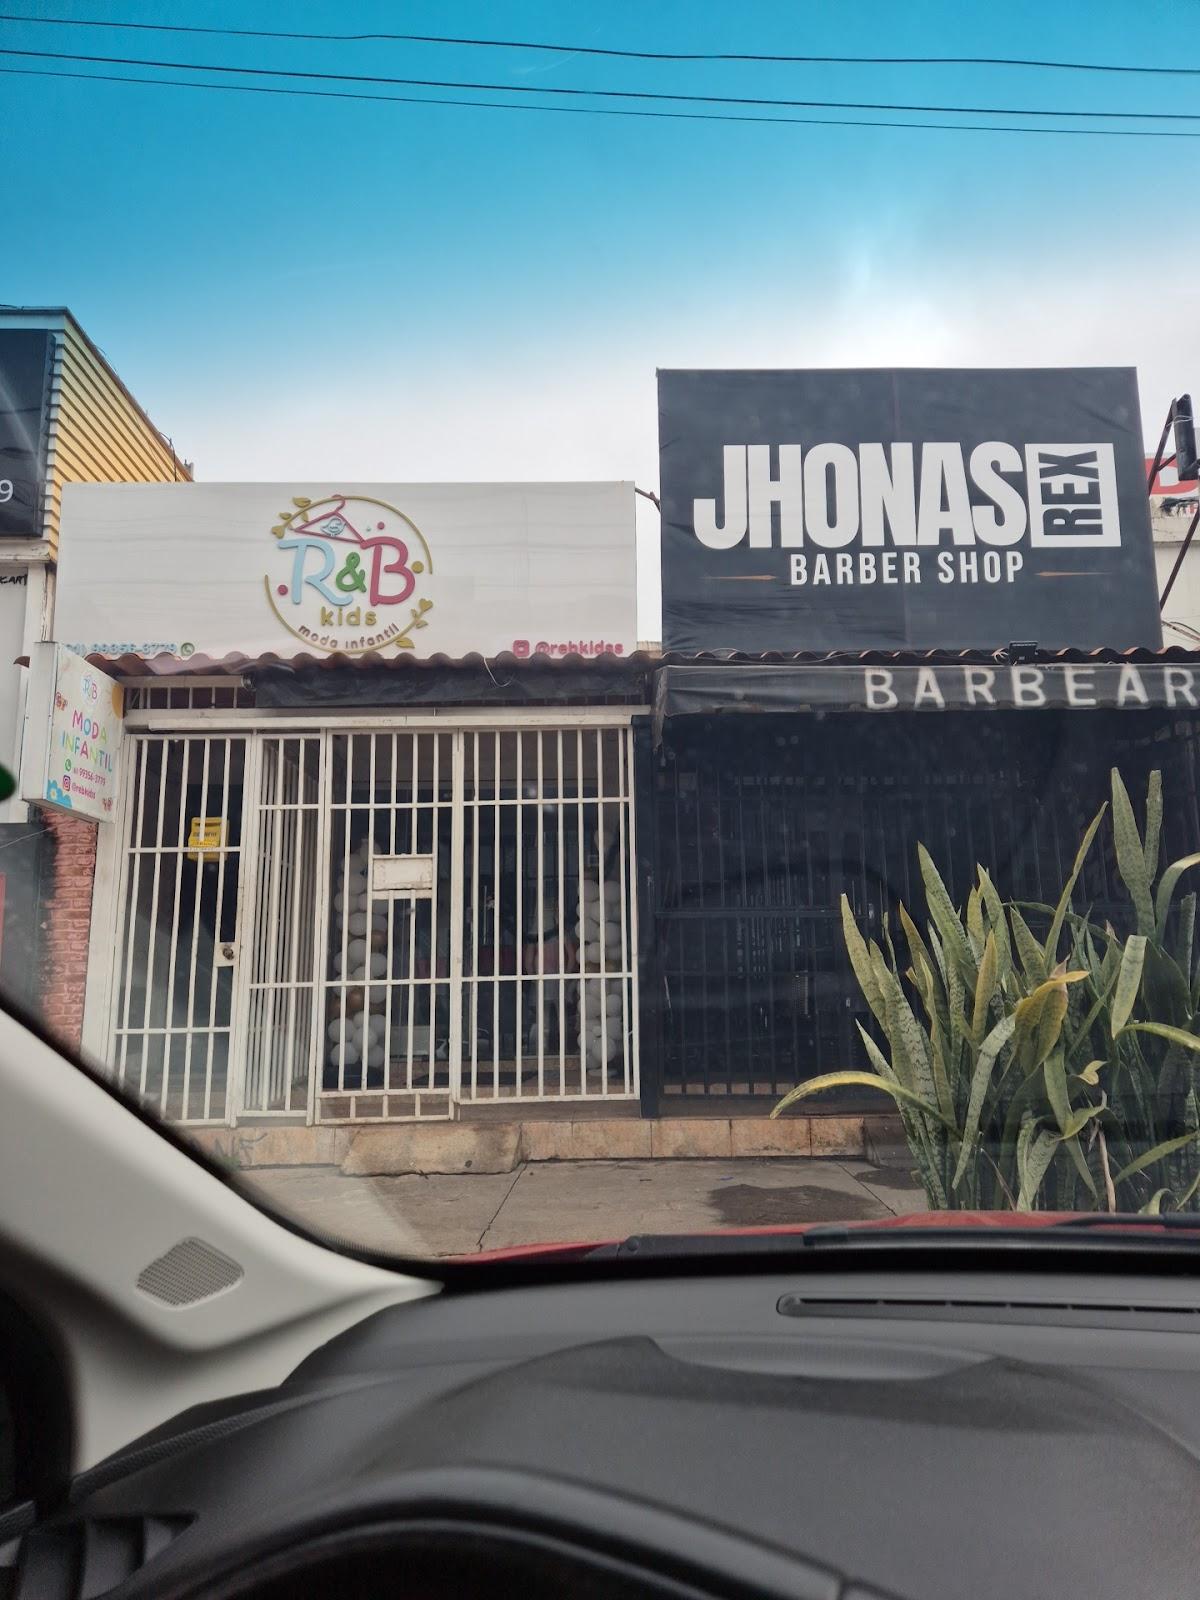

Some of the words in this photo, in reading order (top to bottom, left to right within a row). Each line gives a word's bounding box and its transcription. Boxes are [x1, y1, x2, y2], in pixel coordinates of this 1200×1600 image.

[693, 441, 1028, 549] JHONAS
[1037, 450, 1104, 536] REX
[277, 535, 416, 607] R&B
[789, 552, 922, 586] BARBER
[937, 550, 1025, 585] SHOP
[320, 606, 378, 627] kids
[298, 624, 339, 649] moda
[72, 709, 107, 744] MODA
[61, 730, 113, 773] INFANTIL
